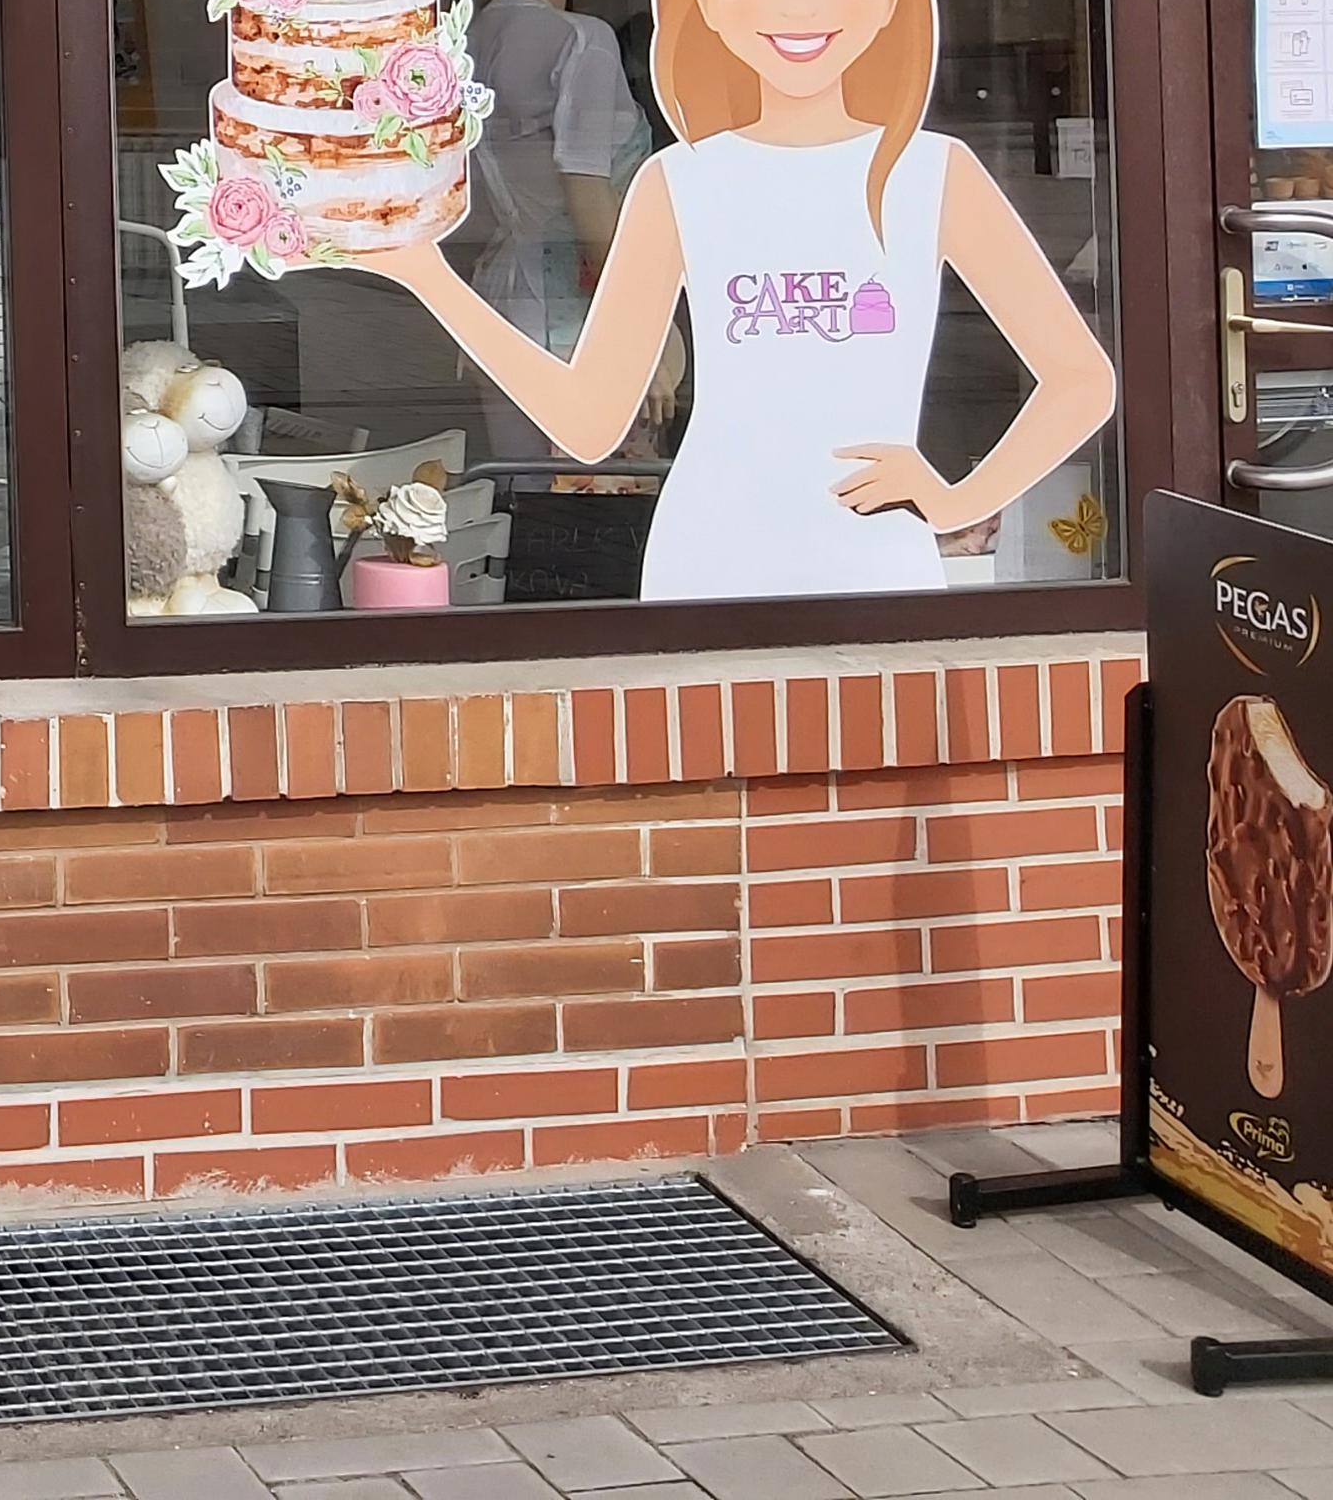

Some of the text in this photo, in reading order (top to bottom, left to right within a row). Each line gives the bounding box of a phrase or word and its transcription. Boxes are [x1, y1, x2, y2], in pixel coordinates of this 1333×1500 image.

[727, 273, 849, 304] CAKE
[1216, 580, 1308, 639] PEGAS
[1234, 627, 1293, 651] PREMIUM
[1243, 1121, 1285, 1156] Prima
